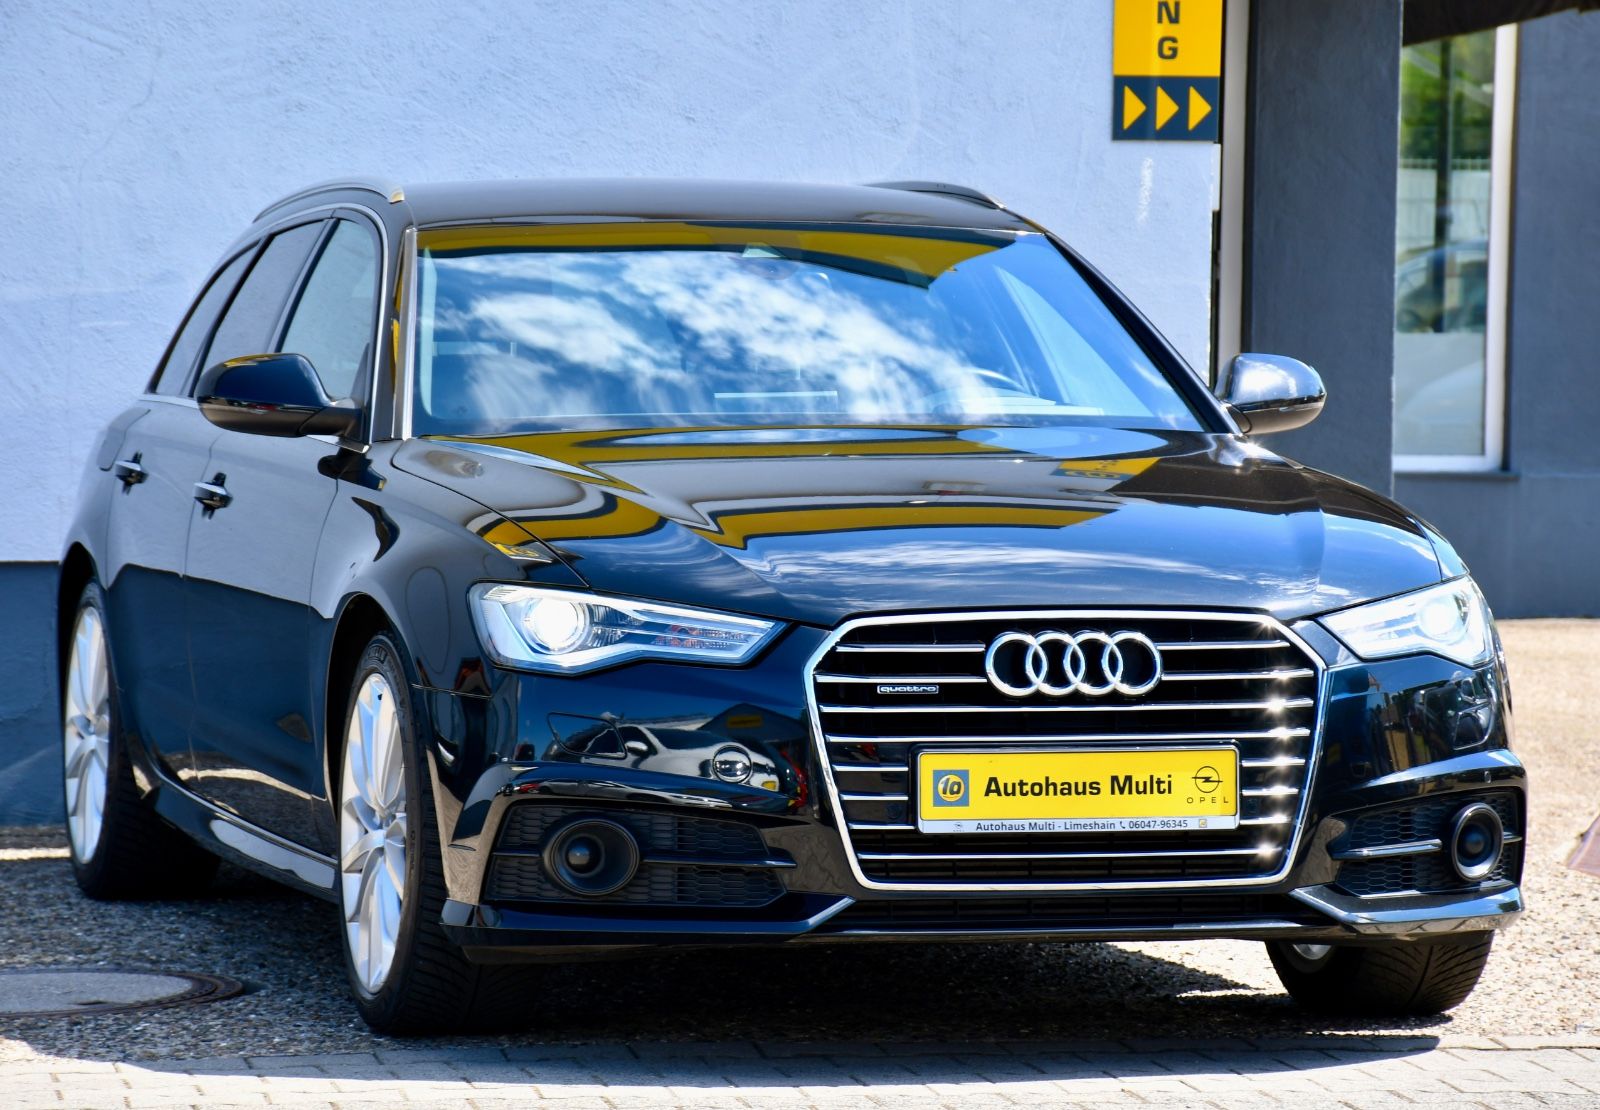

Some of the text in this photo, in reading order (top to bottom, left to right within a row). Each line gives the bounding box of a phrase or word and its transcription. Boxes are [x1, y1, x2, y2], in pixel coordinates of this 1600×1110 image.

[984, 774, 1172, 797] Autohaus Multi
[1186, 796, 1229, 804] OPEL
[975, 822, 1026, 832] Autohaus
[1028, 821, 1055, 831] Multi
[1064, 820, 1116, 831] Limeshain
[1128, 819, 1188, 829] 06047-96345
